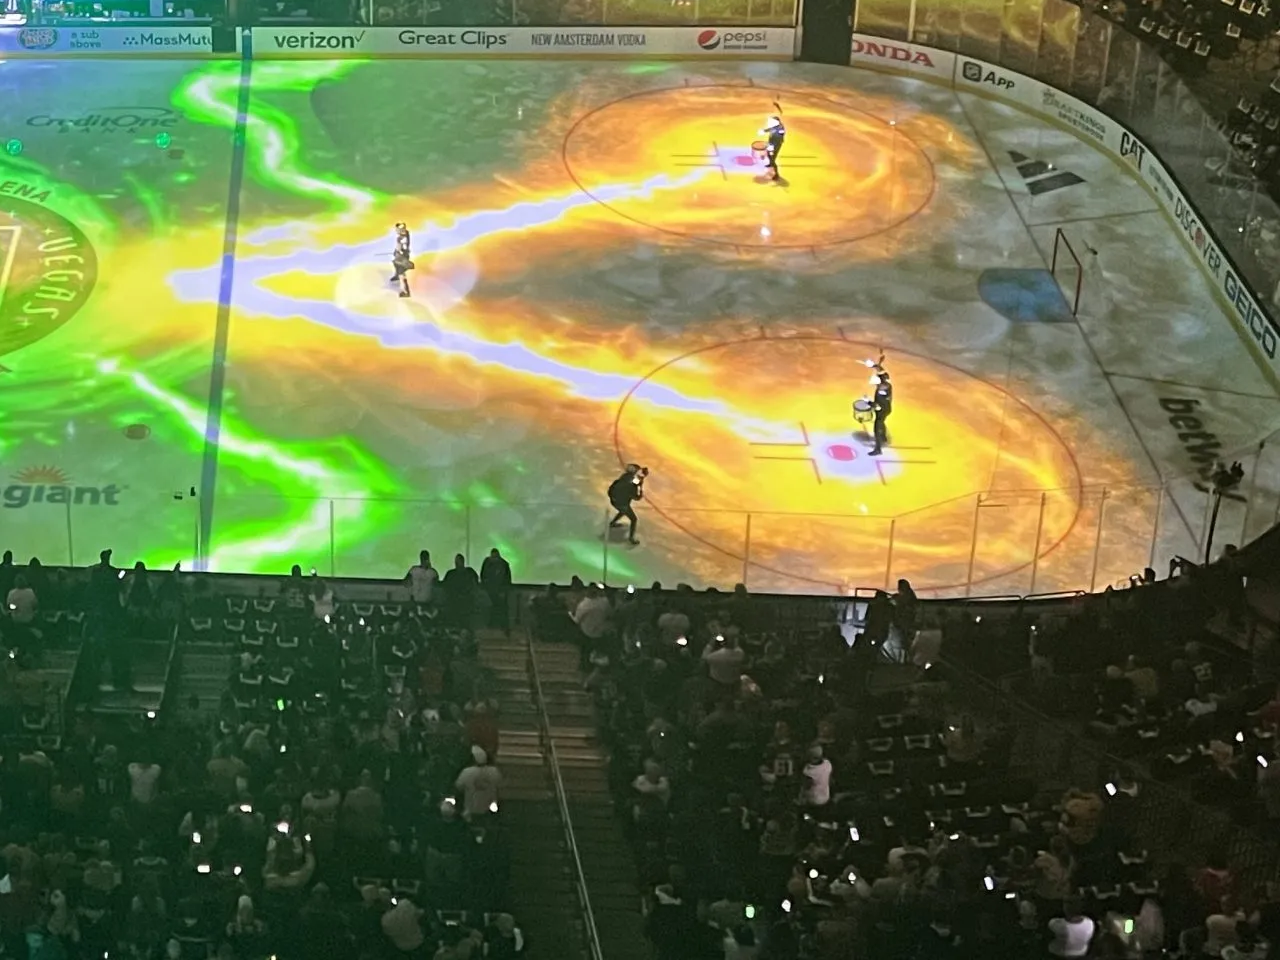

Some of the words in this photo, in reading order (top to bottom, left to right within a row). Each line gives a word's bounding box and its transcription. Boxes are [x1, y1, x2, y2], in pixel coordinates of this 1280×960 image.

[140, 33, 213, 45] MassMutu
[273, 31, 355, 49] verizon
[398, 30, 457, 45] Great
[461, 30, 507, 49] Clips
[531, 34, 551, 46] NEW
[554, 34, 614, 46] AMSTERDAM
[618, 34, 646, 46] VODKA
[723, 30, 767, 44] pepsi
[852, 40, 935, 68] ONDA
[1120, 131, 1146, 171] CAT
[1175, 196, 1221, 279] DISCOVER
[22, 236, 84, 320] VEGAS
[1224, 269, 1277, 360] GEICO
